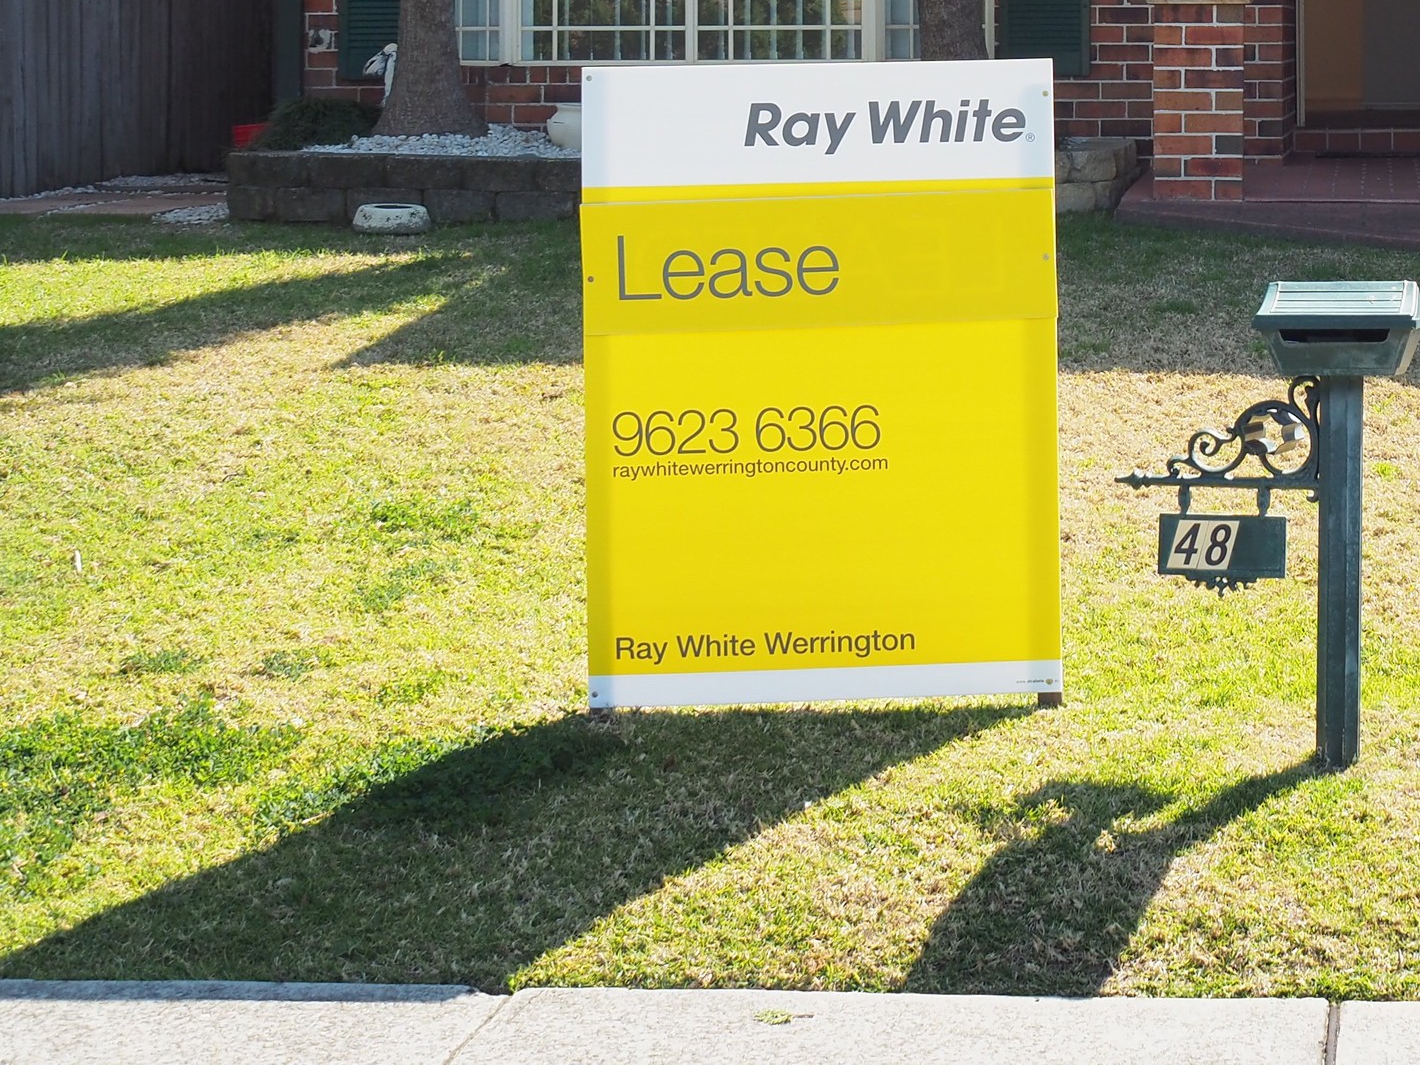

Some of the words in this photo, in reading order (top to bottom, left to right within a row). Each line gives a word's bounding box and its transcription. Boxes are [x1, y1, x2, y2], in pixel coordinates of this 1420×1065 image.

[744, 102, 856, 154] Ray
[869, 99, 1026, 144] White
[617, 236, 839, 300] Lease
[612, 409, 739, 456] 9623
[755, 405, 881, 452] 6366
[613, 456, 888, 480] raywhitewerringtoncounty.com
[1174, 523, 1231, 566] 48
[616, 637, 668, 665] Ray
[677, 634, 755, 658] White
[764, 630, 915, 658] Werrington
